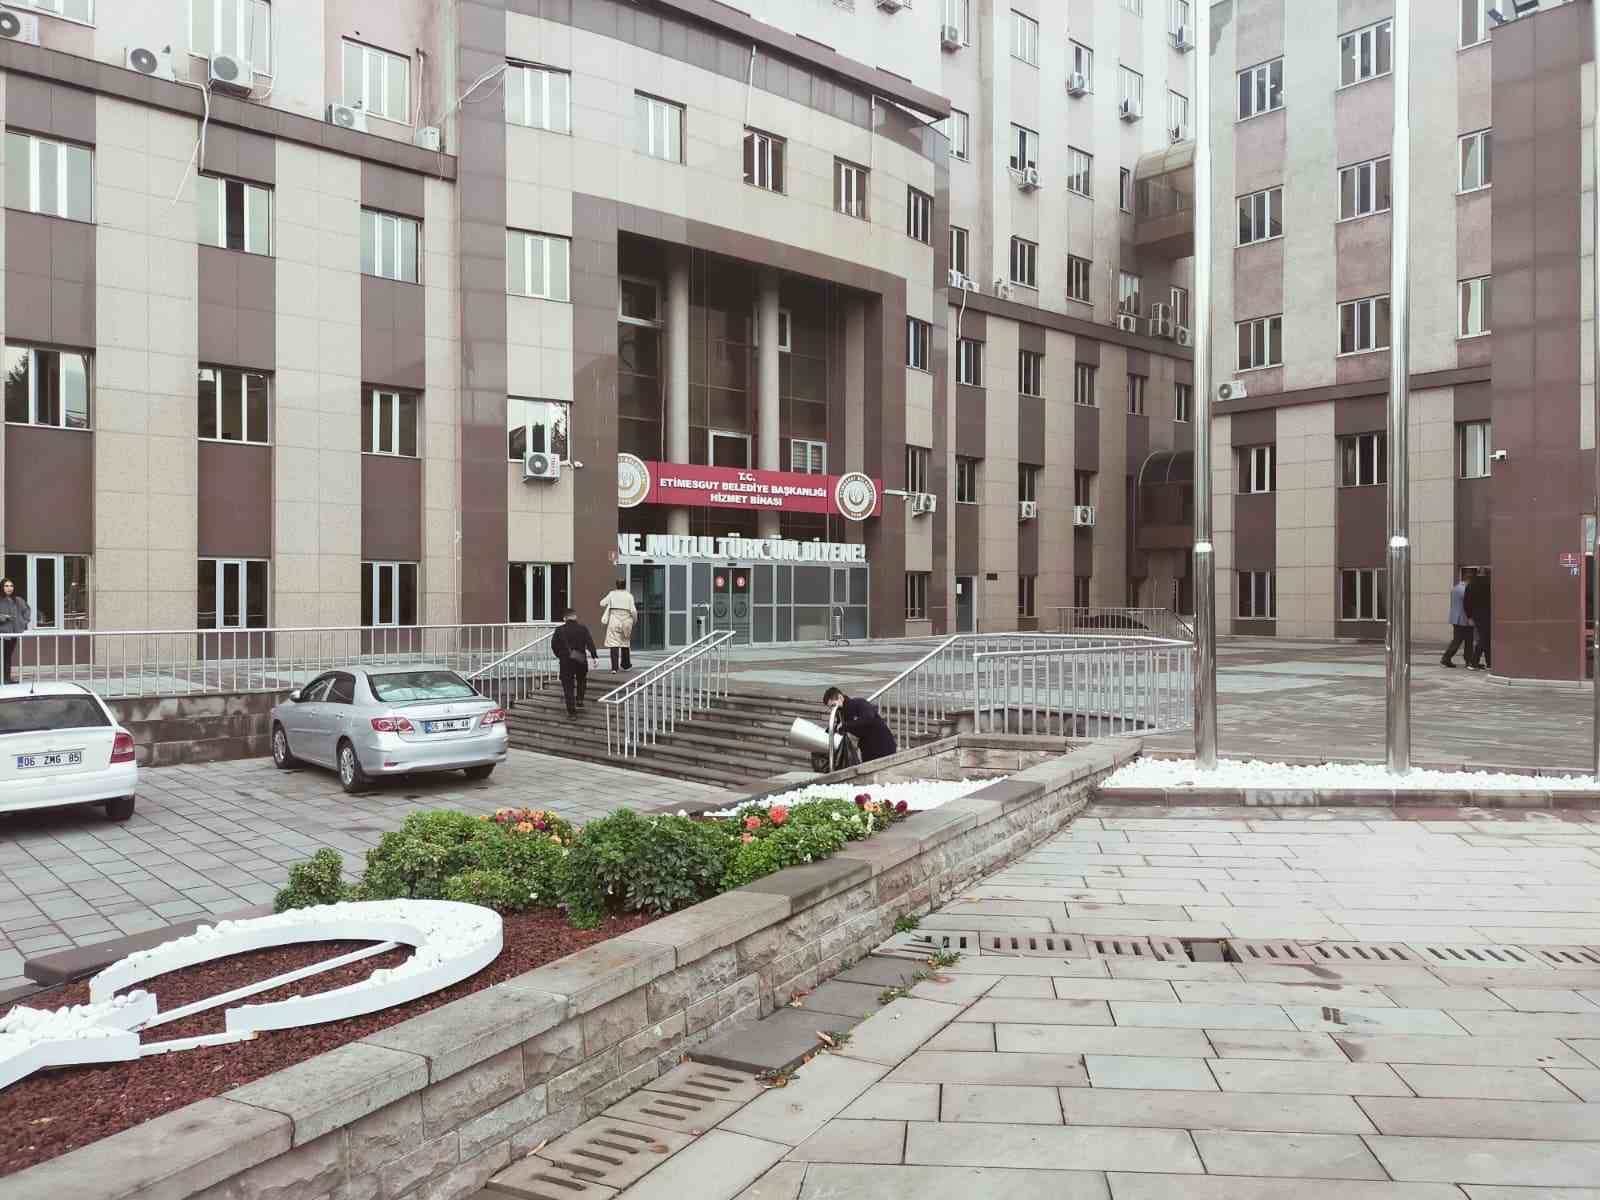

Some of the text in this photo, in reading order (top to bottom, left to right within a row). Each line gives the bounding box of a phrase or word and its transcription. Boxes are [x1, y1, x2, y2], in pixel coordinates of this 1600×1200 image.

[738, 472, 756, 481] T.C.
[660, 477, 827, 498] ETİMESGUT BELEDİYE BAŞKANLIĞI
[710, 492, 782, 507] HİZMET BİNASI
[646, 534, 714, 558] MUTLU
[24, 756, 35, 766] 06
[43, 754, 61, 765] ZMG
